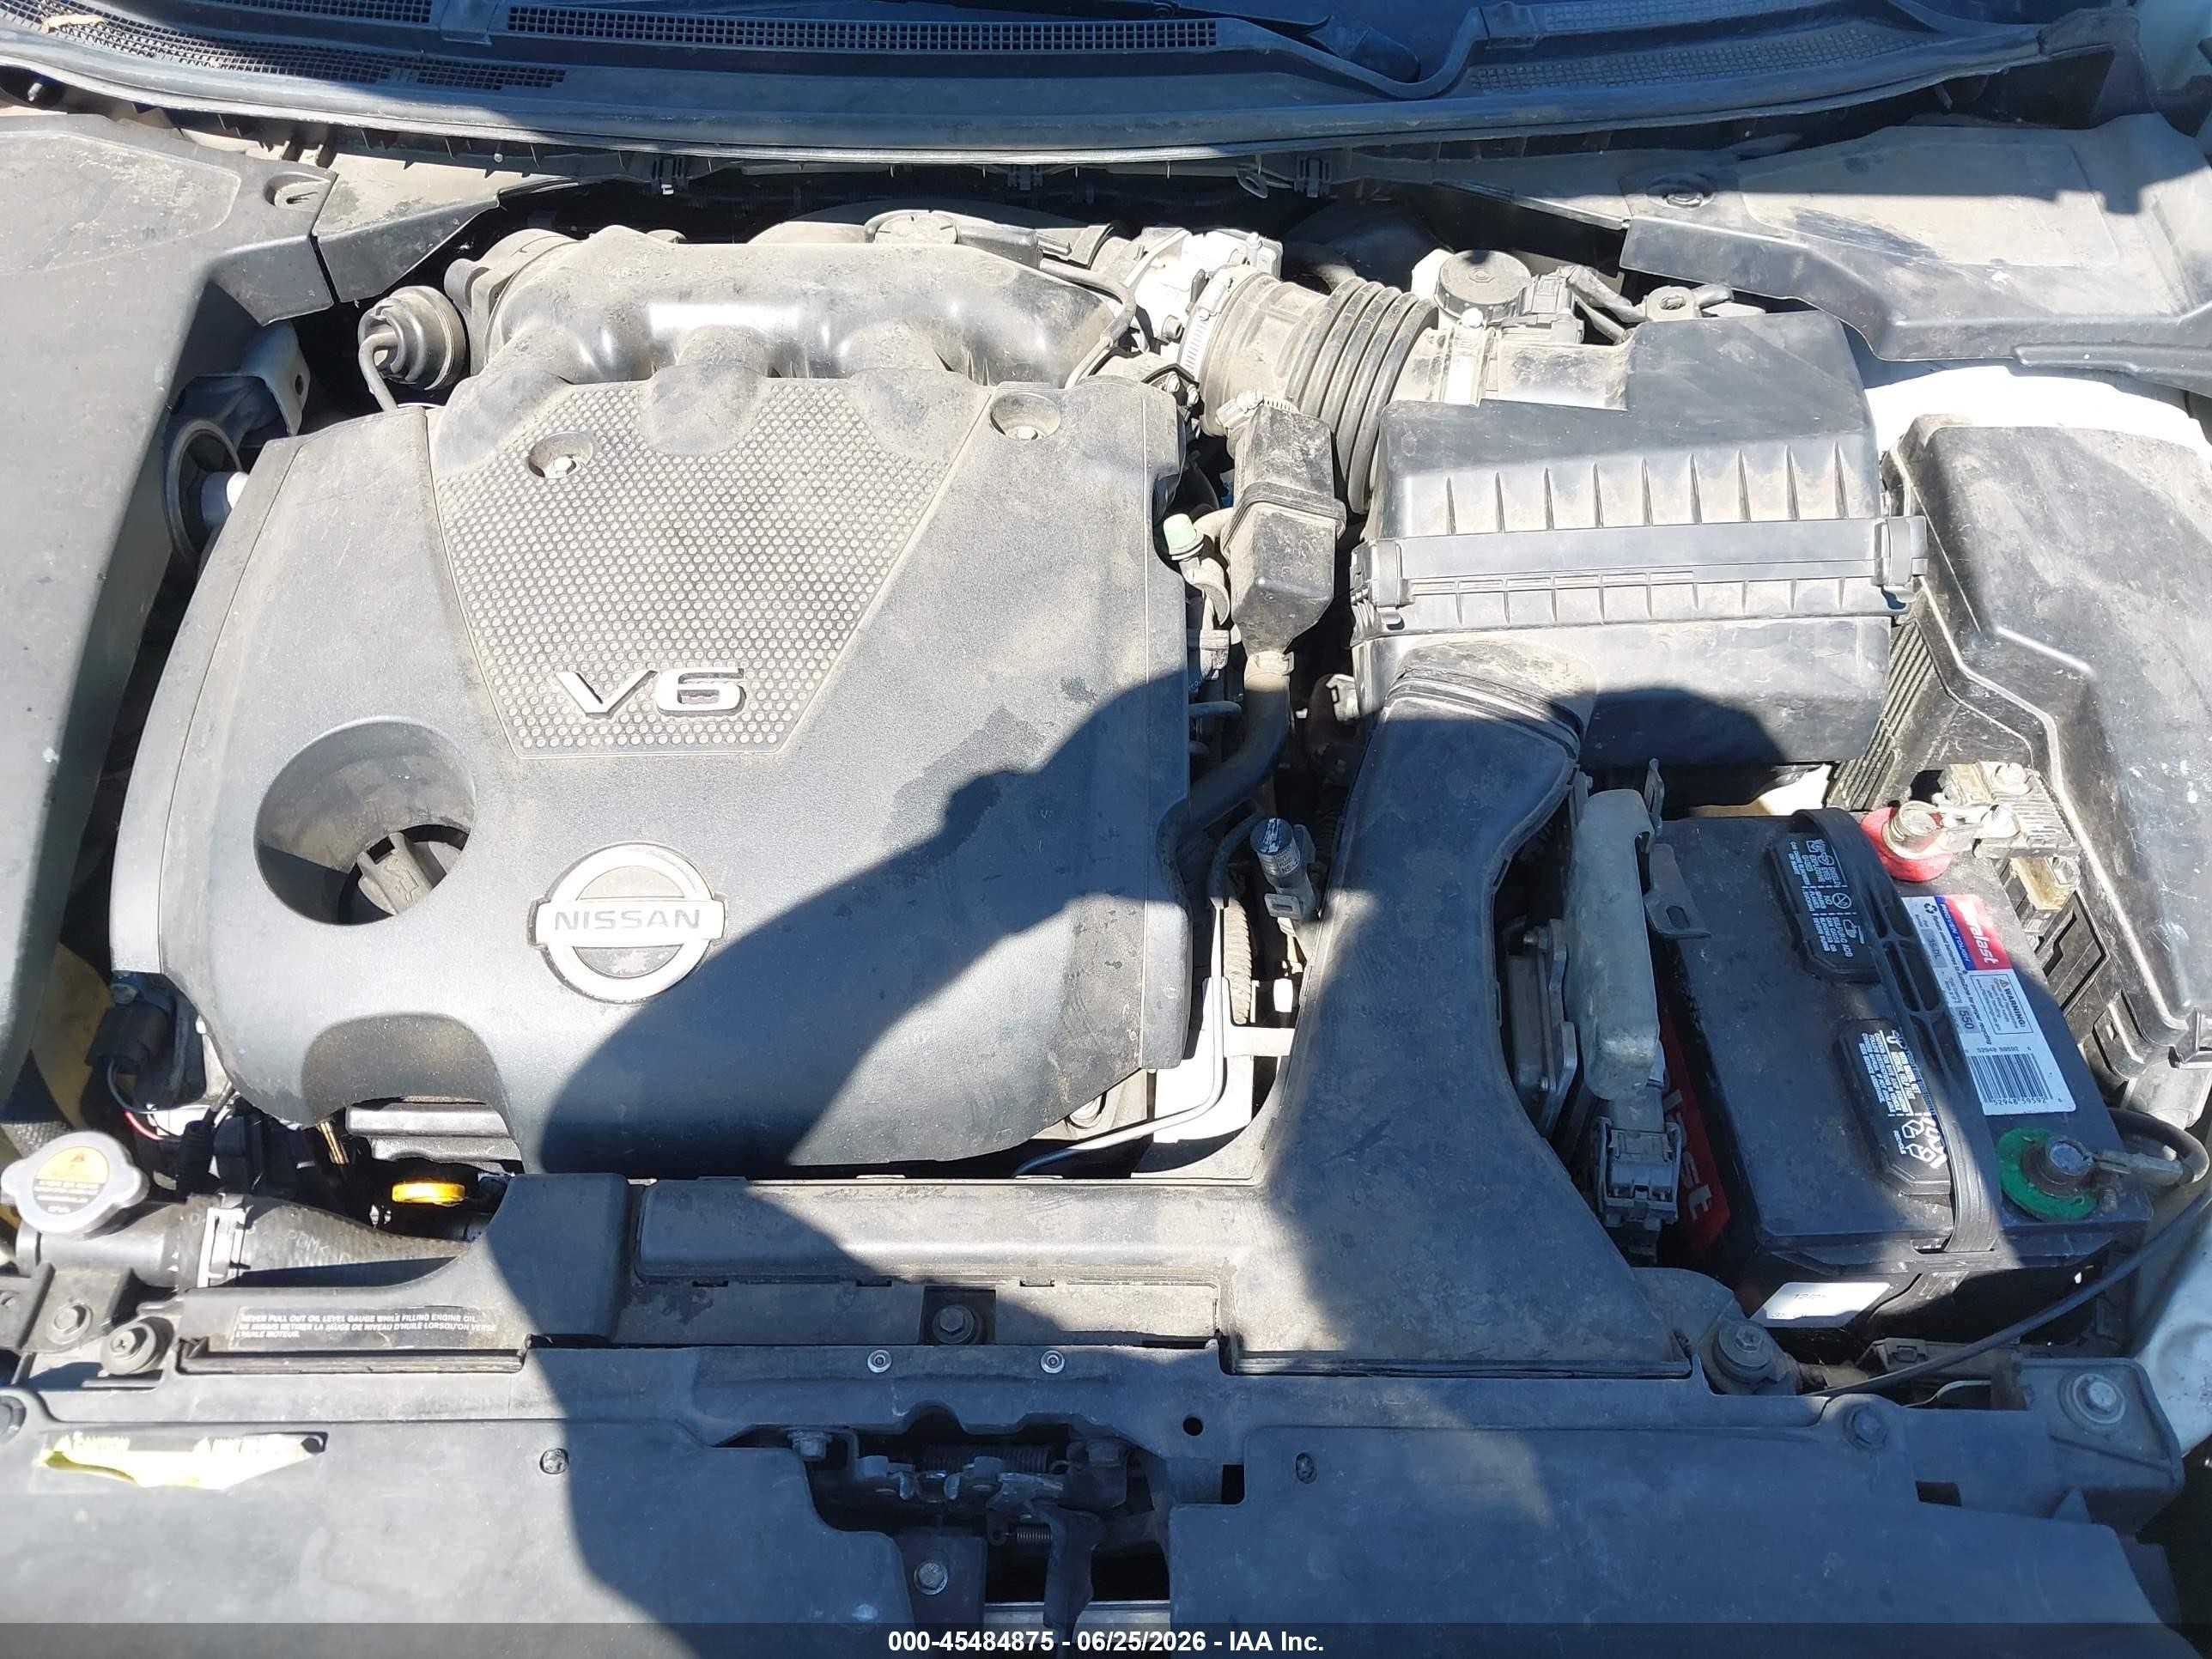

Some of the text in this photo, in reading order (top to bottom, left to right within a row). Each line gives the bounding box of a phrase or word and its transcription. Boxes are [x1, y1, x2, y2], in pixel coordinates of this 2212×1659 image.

[555, 667, 746, 717] V6
[554, 909, 701, 931] NISSAN
[1941, 904, 1970, 962] PROVEN TOUGH
[1959, 1011, 1974, 1029] 550
